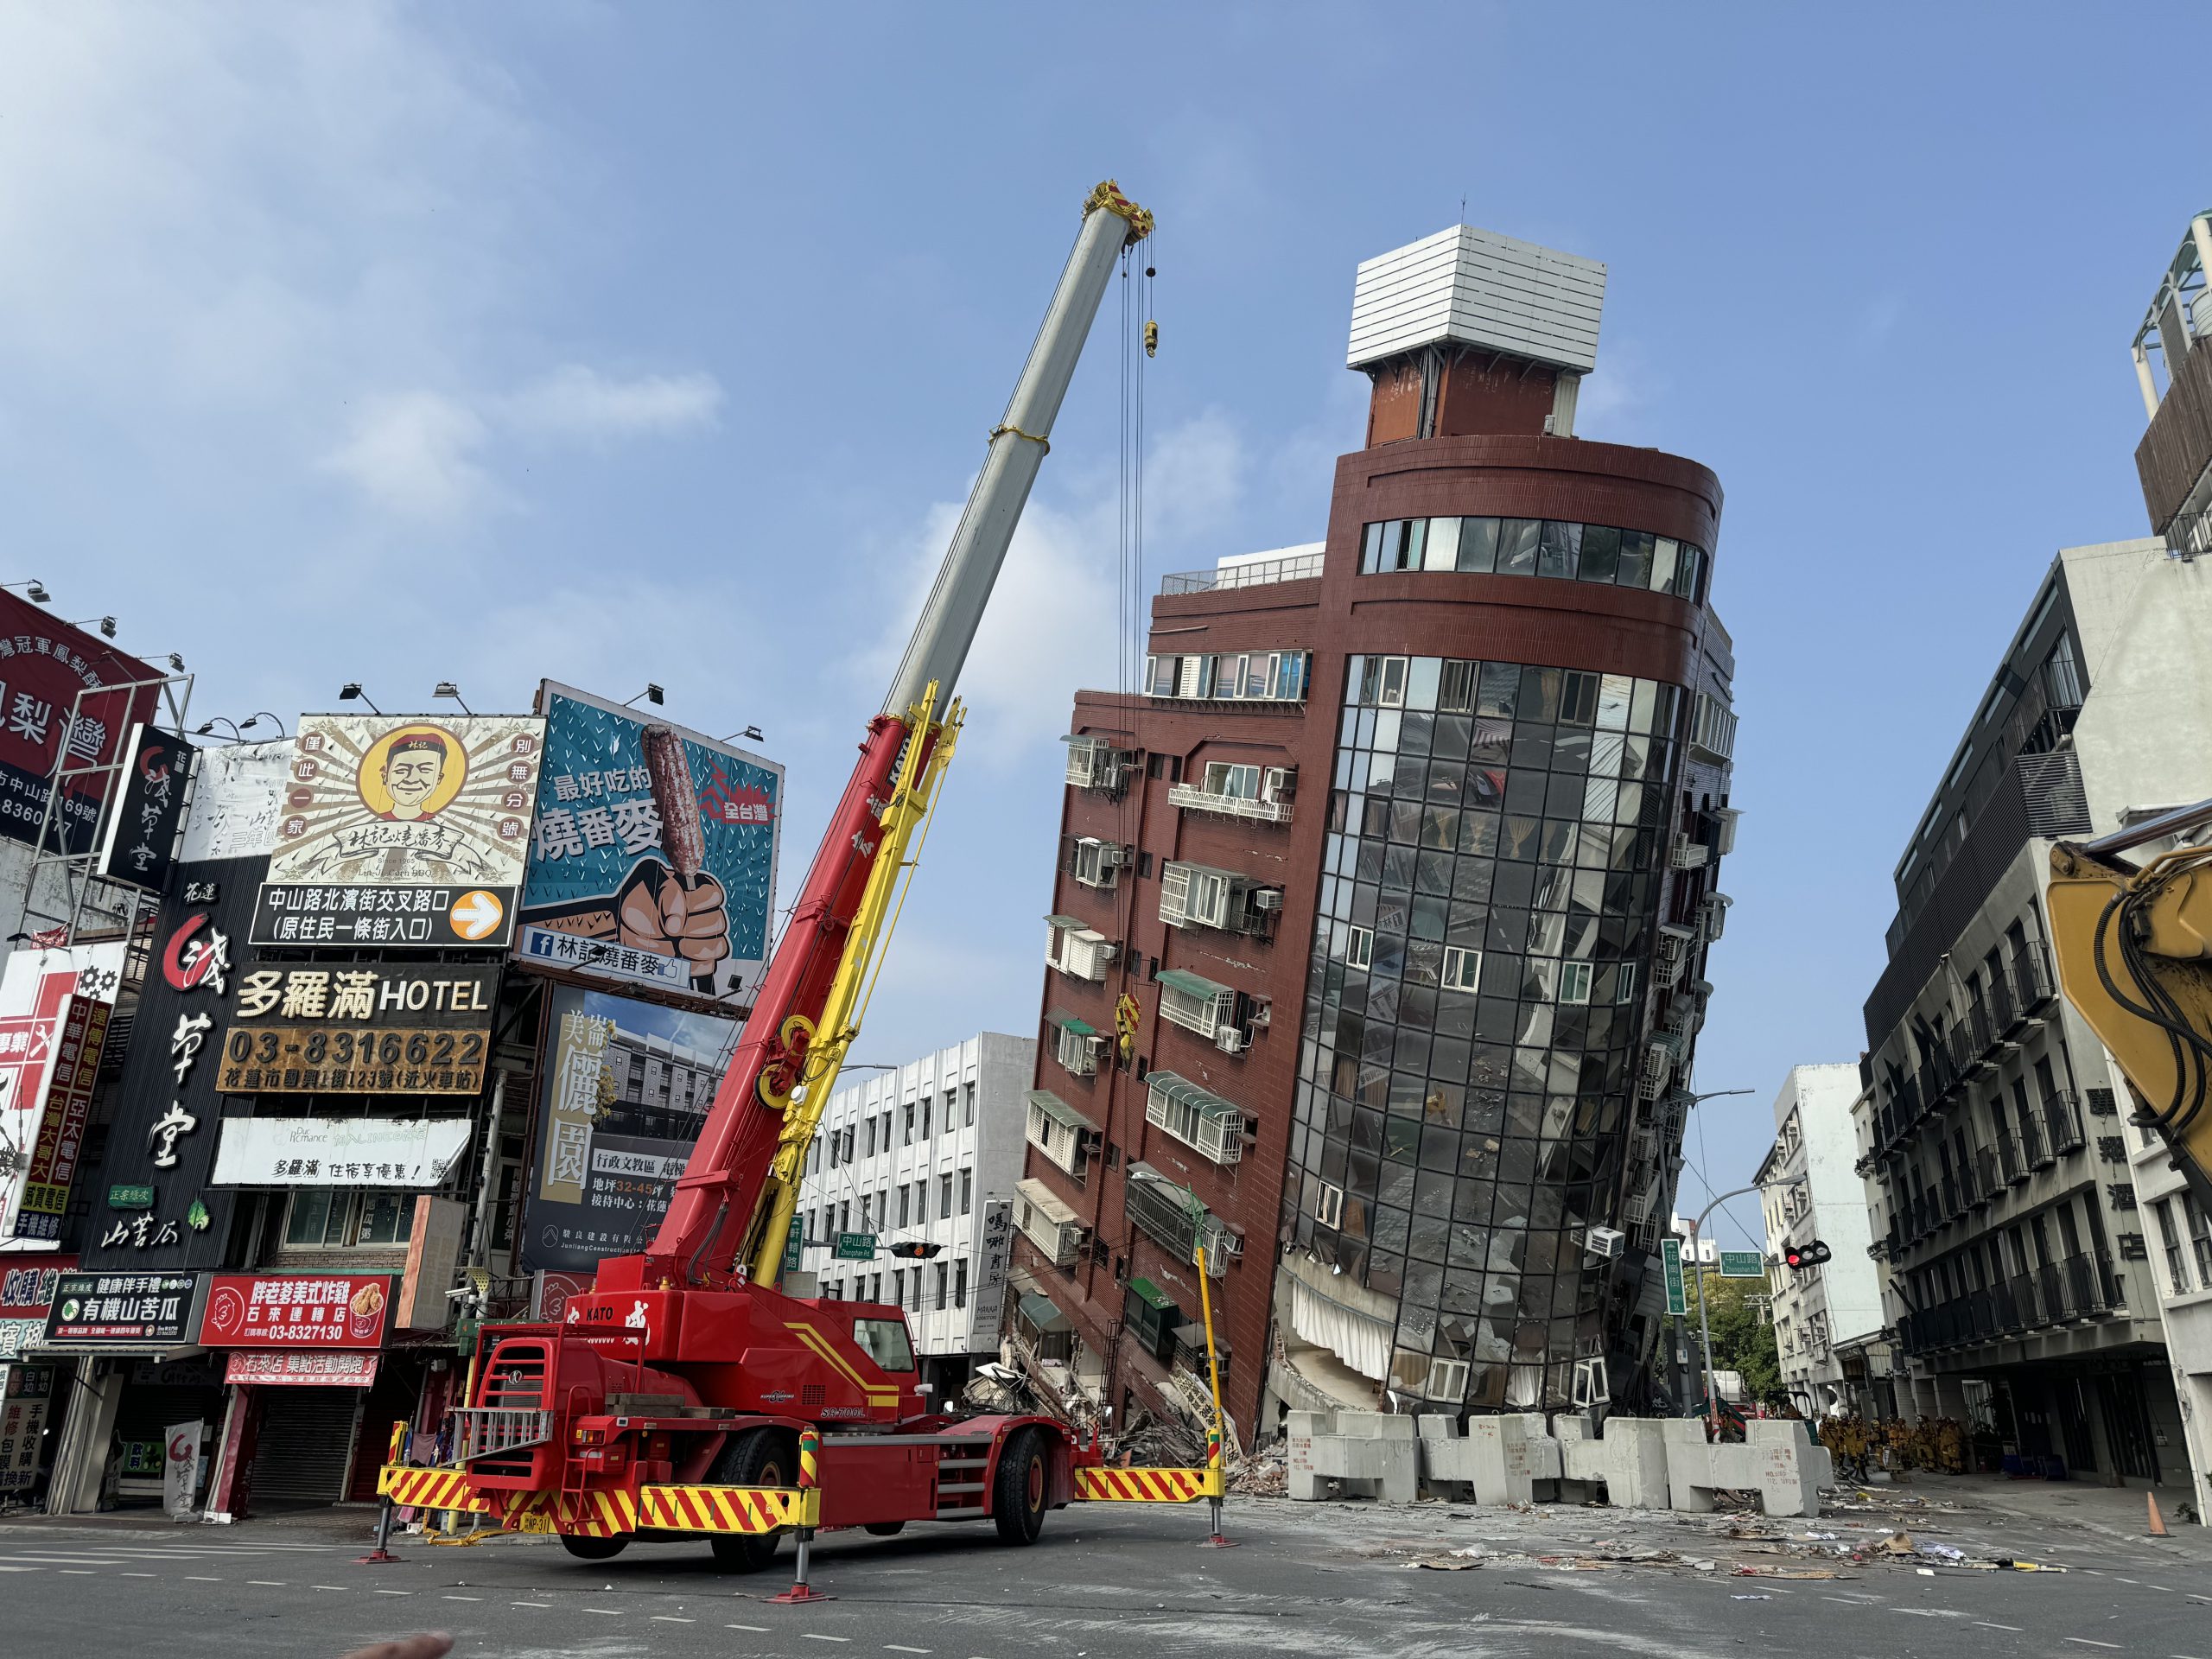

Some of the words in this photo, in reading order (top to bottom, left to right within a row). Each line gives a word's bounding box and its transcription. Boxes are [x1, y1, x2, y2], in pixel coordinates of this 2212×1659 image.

[408, 740, 428, 750] 林記
[890, 737, 911, 785] KATO
[287, 735, 322, 835] 僅此一家
[501, 737, 532, 837] 別無分號
[552, 765, 653, 804] 最好吃的
[723, 801, 769, 822] 全台灣
[532, 798, 664, 862] 燒番麥
[268, 887, 449, 912] 中山路北濱街交叉路口
[556, 935, 659, 976] 林記燒番麥
[237, 970, 379, 1020] 多羅滿
[378, 979, 489, 1011] HOTEL
[55, 1002, 88, 1083] 中華電信
[78, 1006, 109, 1087] 遠傳電信
[228, 1030, 484, 1065] 03-8316622
[30, 1094, 65, 1179] 台灣大哥大
[54, 1097, 87, 1182] 亞太電信
[596, 1153, 656, 1173] 行政文教區
[22, 1184, 67, 1211] 威寶電信
[16, 1212, 60, 1238] 手機維修
[100, 1211, 178, 1248] 山苦瓜
[842, 1235, 872, 1248] 中山路
[1666, 1249, 1680, 1287] 花崗街
[1725, 1253, 1758, 1264] 中山路
[0, 1267, 79, 1306] 收購維
[97, 1277, 162, 1294] 健康伴手禮
[250, 1281, 351, 1306] 胖老爹美式炸雞
[82, 1297, 181, 1322] 有機山苦瓜
[246, 1306, 347, 1323] 石來運轉店
[587, 1306, 614, 1321] KATO
[269, 1325, 344, 1341] 03-8327130
[820, 1407, 865, 1418] SR-700L
[18, 1403, 43, 1467] 手機收購
